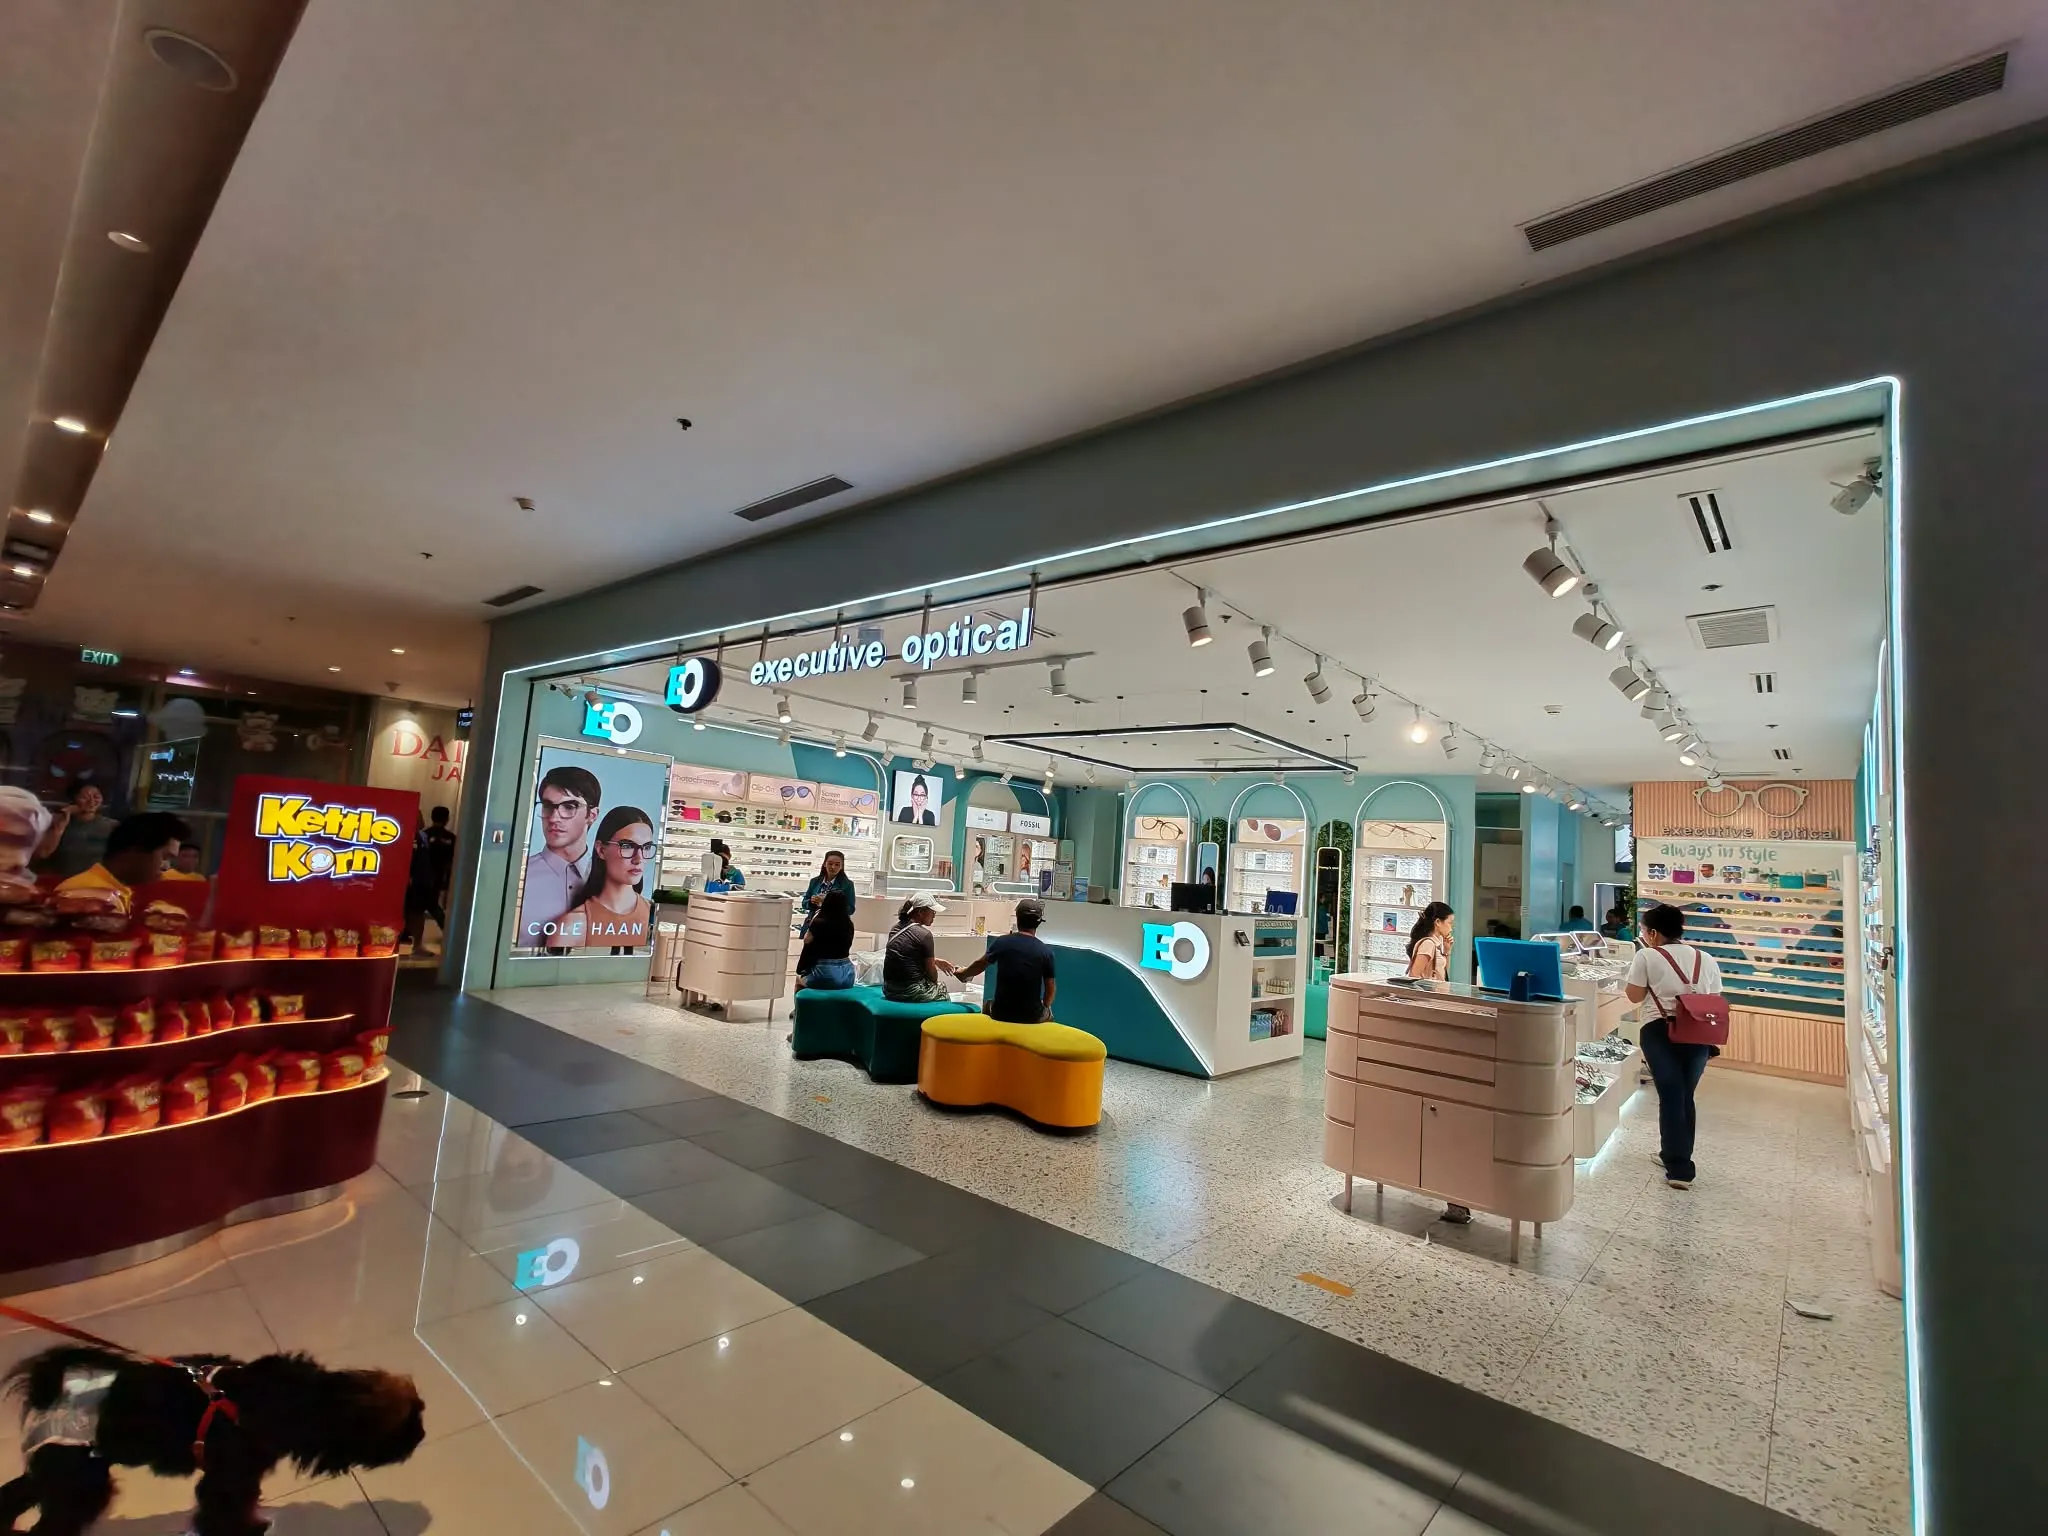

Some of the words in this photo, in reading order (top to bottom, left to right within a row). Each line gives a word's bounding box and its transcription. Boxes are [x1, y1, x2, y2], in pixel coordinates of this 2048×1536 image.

[81, 649, 114, 666] EXIT
[750, 635, 887, 686] executive
[901, 607, 1034, 670] optical
[664, 658, 704, 709] EO
[582, 701, 643, 745] EO
[255, 793, 401, 844] Kettle
[1019, 820, 1041, 830] FOSSIL
[1662, 825, 1754, 839] executive
[1767, 825, 1840, 841] optical
[269, 839, 380, 882] Korn
[1660, 843, 1713, 861] always
[1717, 842, 1734, 859] in
[527, 921, 584, 936] COLE
[591, 921, 643, 936] HAAN
[1139, 921, 1210, 980] EO
